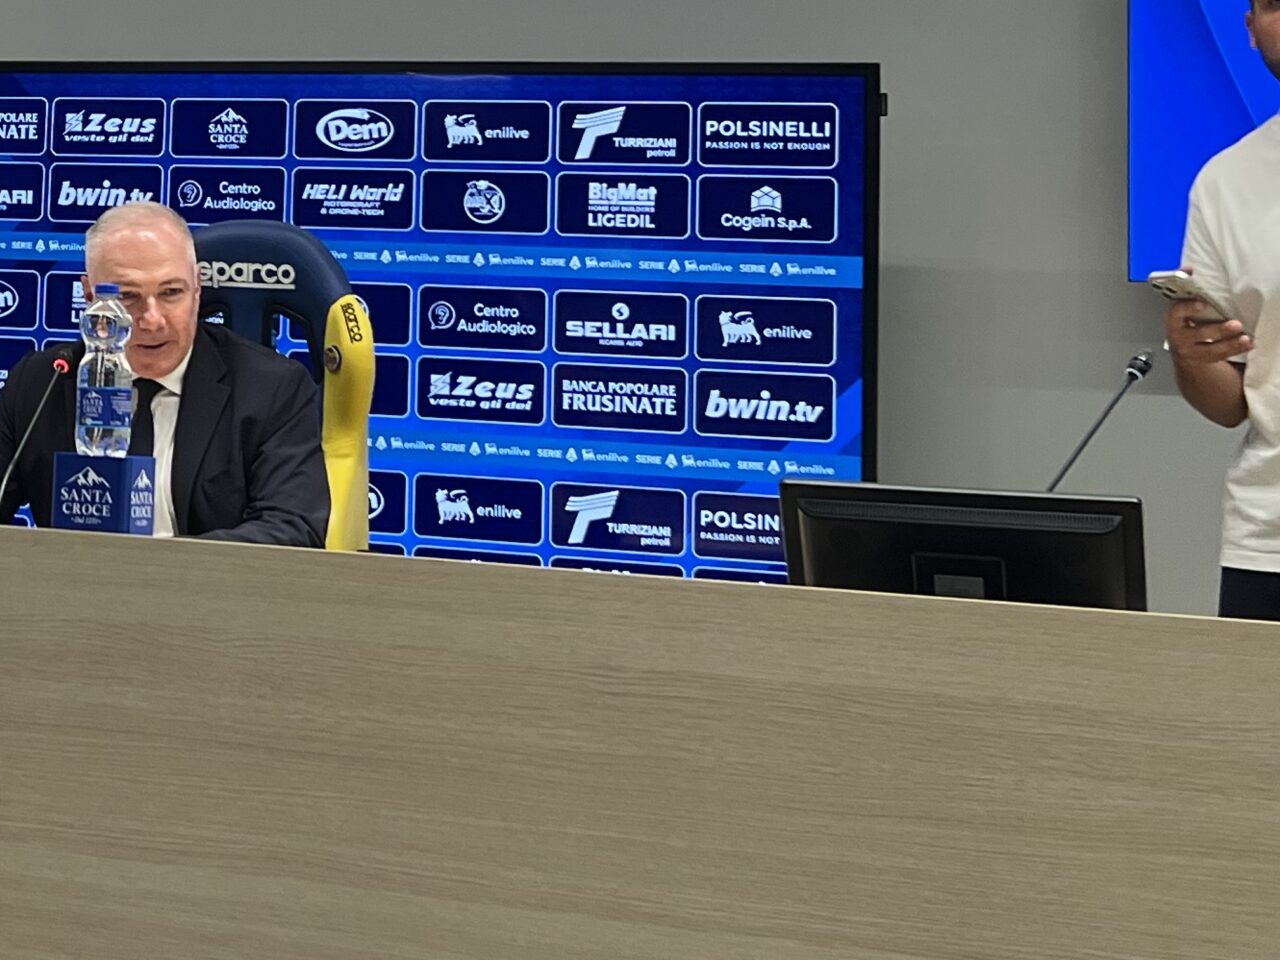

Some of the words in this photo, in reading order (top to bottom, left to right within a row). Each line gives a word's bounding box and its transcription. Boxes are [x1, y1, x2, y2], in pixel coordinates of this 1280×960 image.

[83, 113, 156, 133] Zeus
[208, 123, 248, 134] SANTA
[327, 119, 388, 142] Dem
[705, 120, 831, 137] POLSINELLI
[210, 134, 247, 144] CROCE
[484, 126, 530, 139] enilive
[612, 137, 677, 148] TURRIZIANI
[705, 141, 748, 149] PASSION
[763, 142, 784, 150] NOT
[57, 180, 153, 206] bwin.tv
[219, 181, 260, 194] Centro
[302, 183, 347, 200] HELI
[349, 183, 404, 201] World
[588, 182, 657, 203] BigMat
[203, 197, 275, 212] Audiologico
[588, 212, 655, 228] LIGEDIL
[720, 213, 775, 231] Cogein
[197, 261, 295, 288] sparco
[473, 302, 520, 318] Centro
[341, 302, 362, 344] sparco
[456, 318, 536, 336] Audiologico
[566, 321, 676, 341] SELLARI
[763, 325, 813, 339] enilive
[451, 375, 535, 400] Zeus
[562, 379, 606, 393] BANCA
[608, 381, 676, 397] POPOLARE
[562, 392, 677, 416] FRUSINATE
[704, 389, 824, 423] bwin.tv
[60, 487, 112, 504] SANTA
[130, 491, 153, 505] SANTA
[62, 502, 111, 517] CROCE
[131, 505, 152, 518] CROCE
[476, 504, 522, 519] enilive
[606, 522, 672, 536] TURRIZIANI
[700, 510, 780, 532] POLSIN
[700, 531, 743, 543] PASSION
[746, 535, 756, 544] IS
[758, 536, 780, 545] NOT
